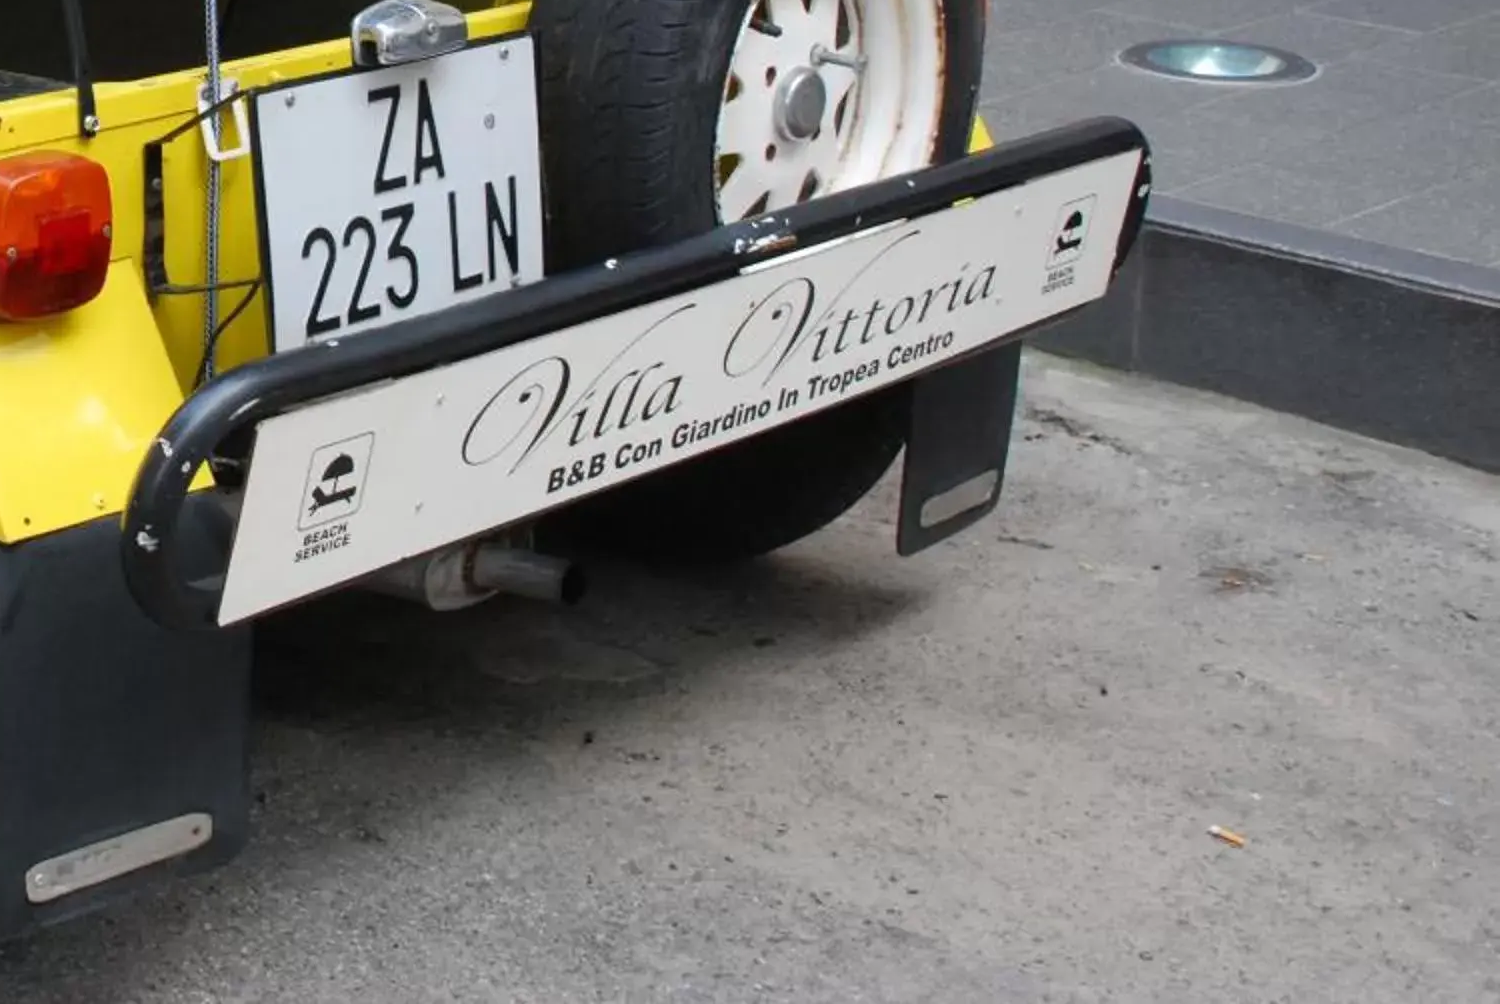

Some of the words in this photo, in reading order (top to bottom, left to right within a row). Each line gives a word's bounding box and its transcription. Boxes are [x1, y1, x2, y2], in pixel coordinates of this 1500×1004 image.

[367, 78, 445, 195] ZA
[301, 202, 419, 337] 223
[447, 175, 519, 292] LN
[462, 303, 696, 477] Villa
[723, 230, 997, 389] Vittoria
[547, 452, 606, 494] B&B
[615, 438, 662, 470] Con
[671, 399, 771, 449] Giardino
[777, 387, 799, 412] In
[808, 357, 880, 399] Tropea
[887, 331, 954, 369] Centro
[292, 534, 352, 563] SERVICE
[302, 522, 349, 546] BEACH
